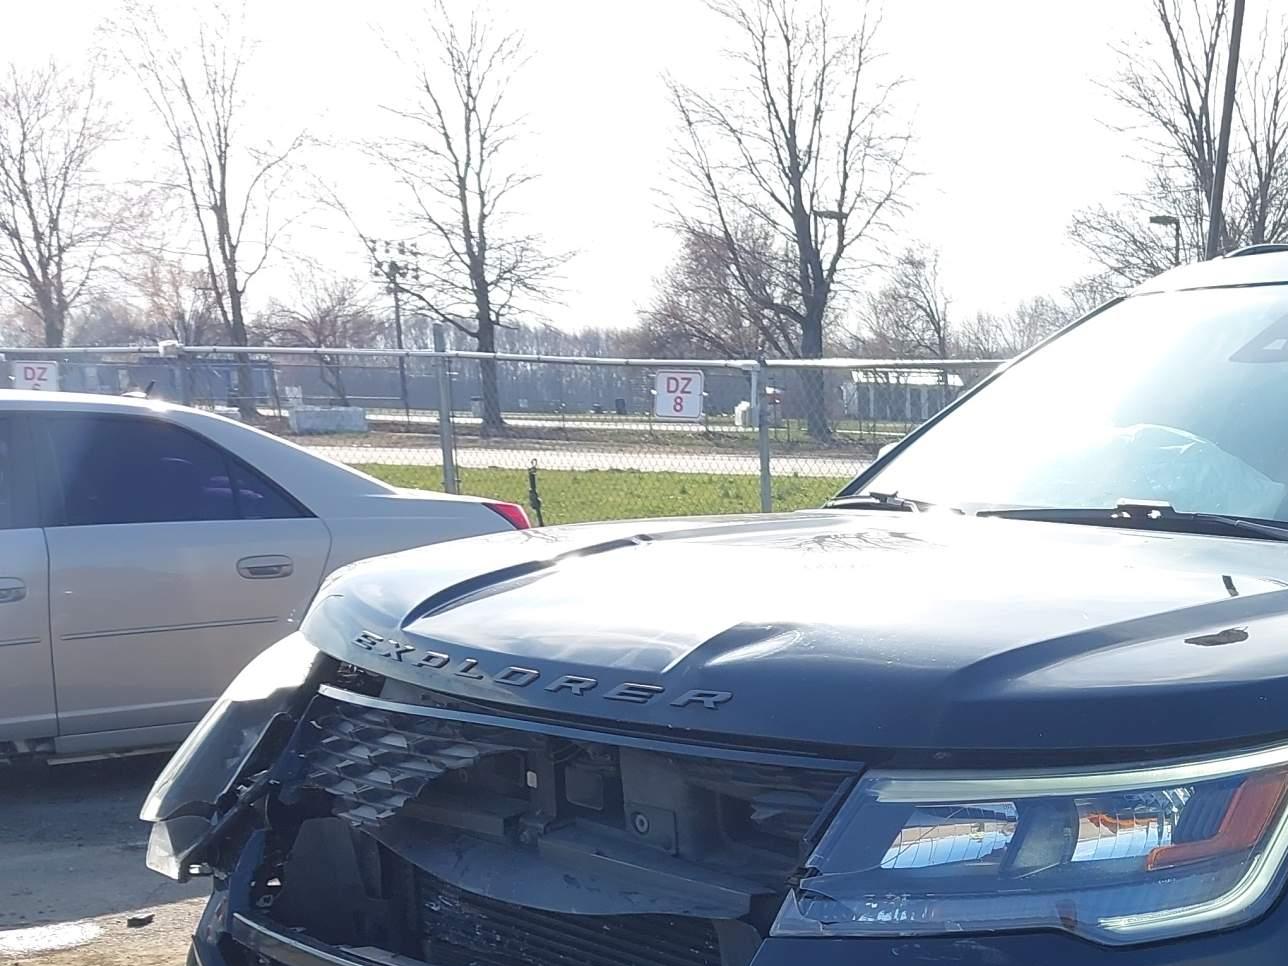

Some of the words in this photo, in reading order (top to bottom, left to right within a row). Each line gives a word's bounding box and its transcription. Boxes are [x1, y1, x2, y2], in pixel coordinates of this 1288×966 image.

[23, 366, 48, 382] DZ
[666, 376, 693, 394] DZ
[673, 396, 684, 413] 8
[351, 630, 734, 710] EXPLORER
